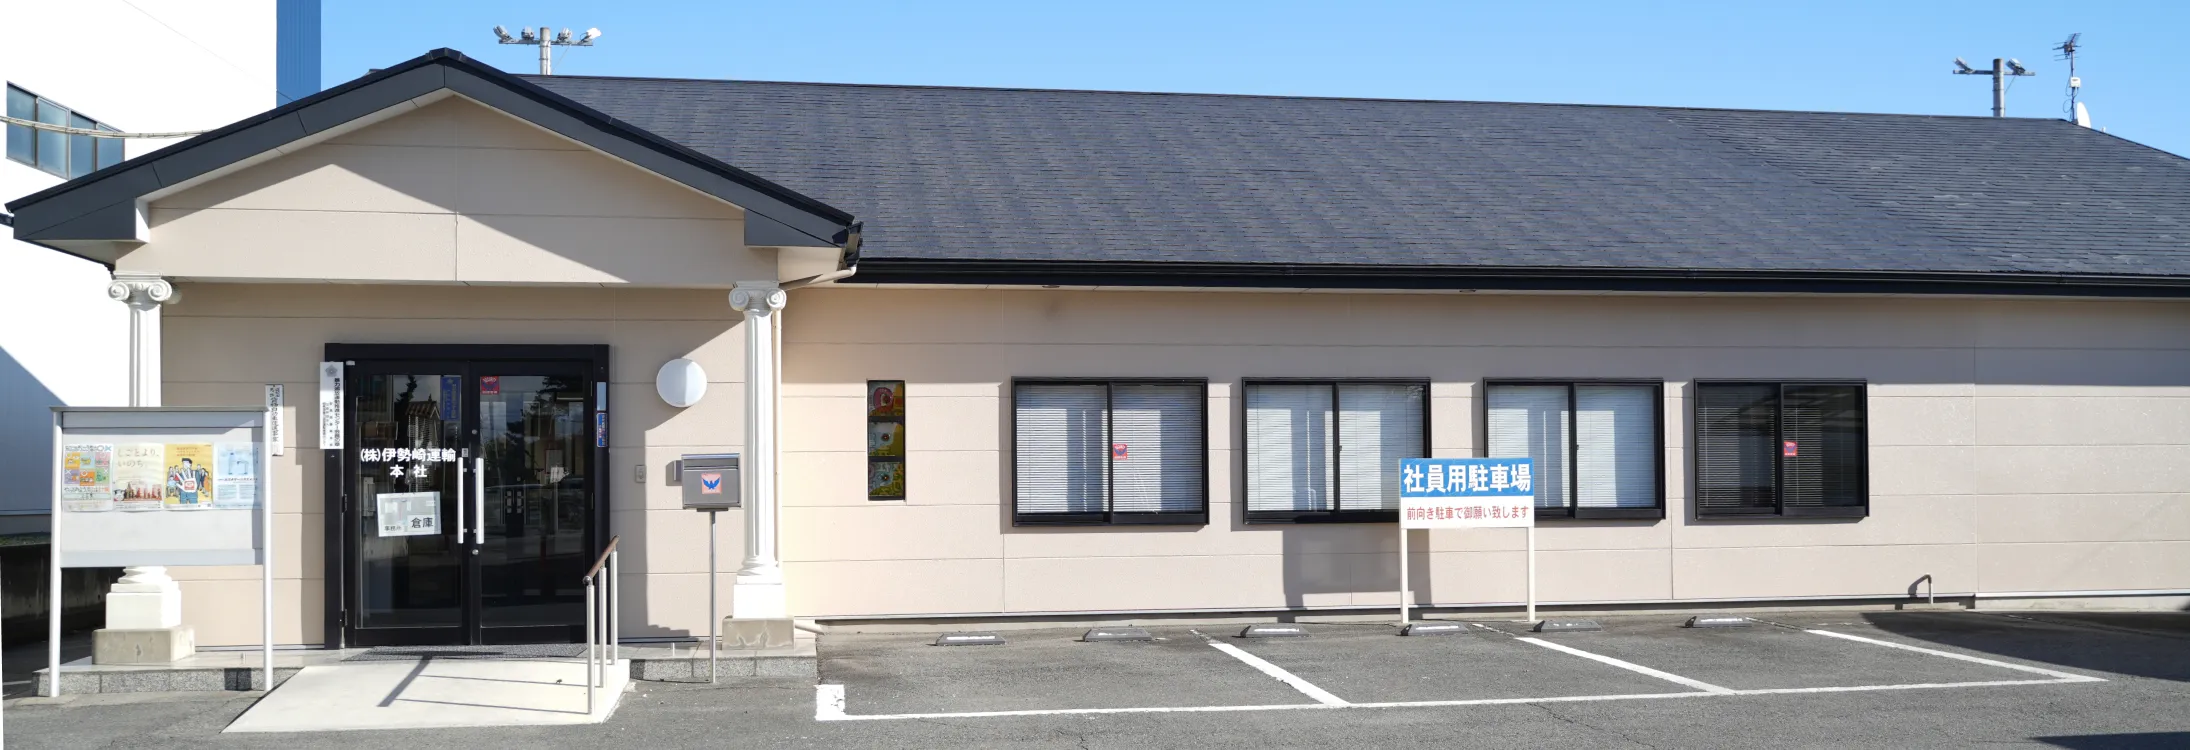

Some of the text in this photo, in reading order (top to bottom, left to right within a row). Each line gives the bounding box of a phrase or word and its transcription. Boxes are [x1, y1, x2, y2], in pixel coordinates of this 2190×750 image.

[360, 447, 457, 463] (株)伊勢崎運輸
[1403, 464, 1532, 493] 社員用駐車場
[1406, 506, 1529, 520] 前向き駐車で御願い致します
[411, 517, 434, 529] 倉庫
